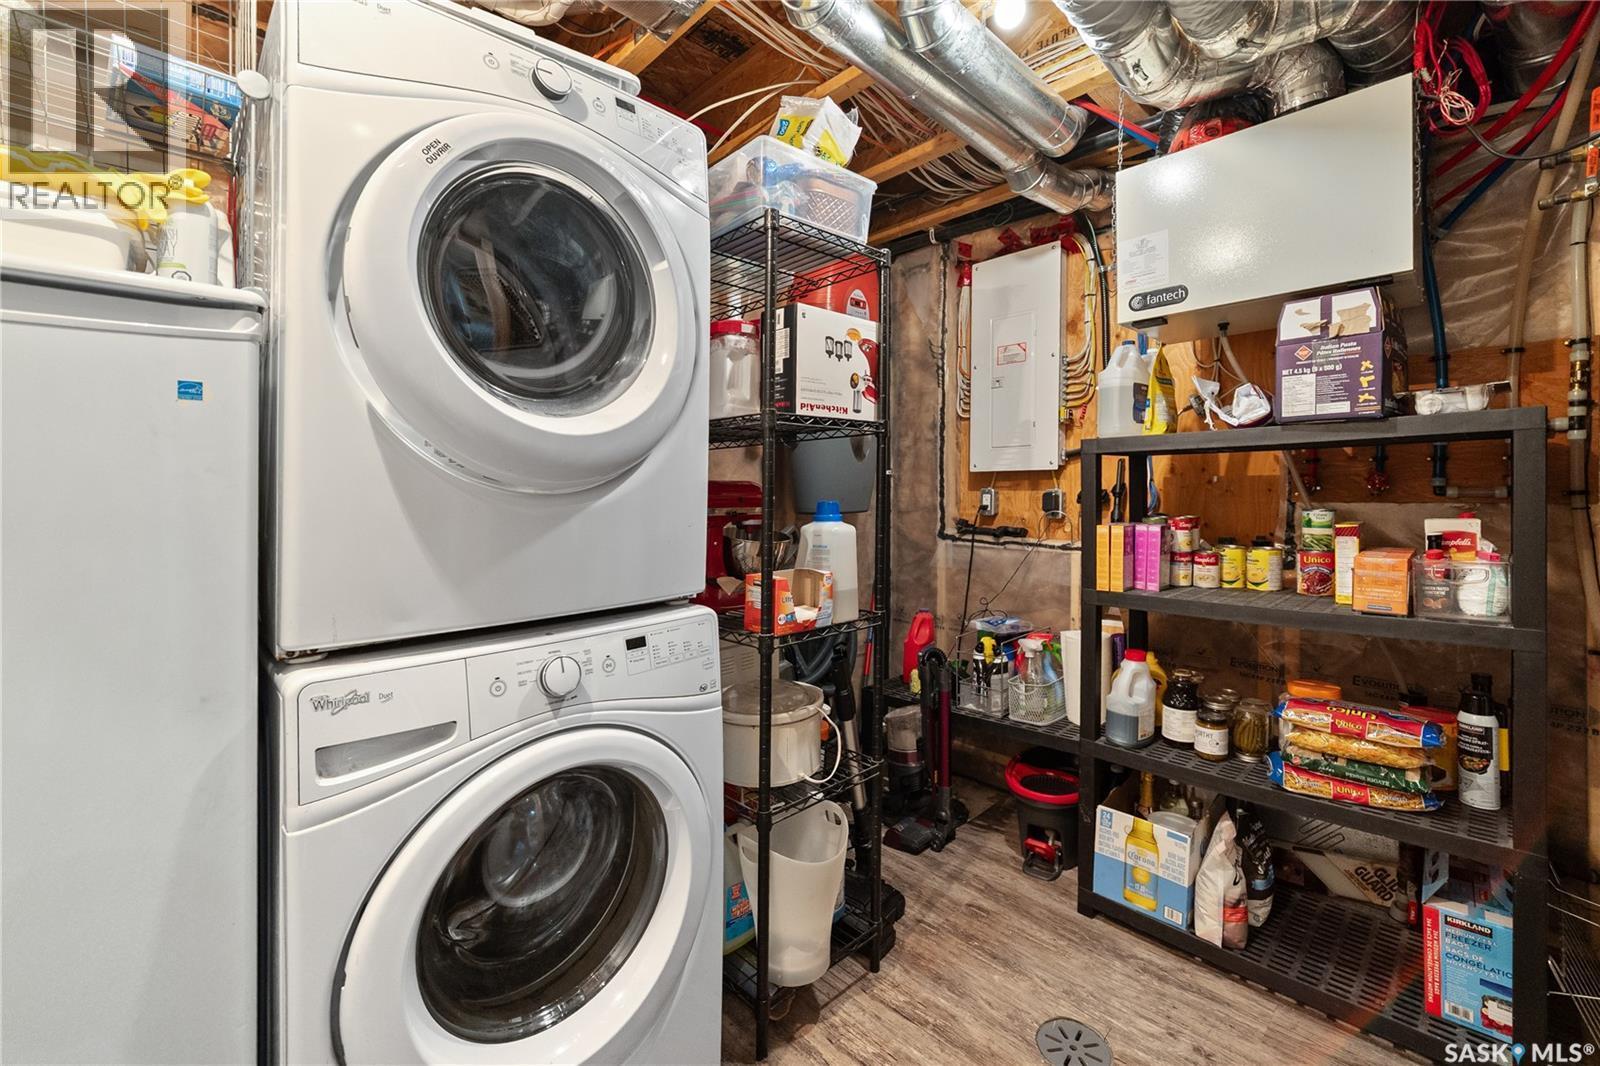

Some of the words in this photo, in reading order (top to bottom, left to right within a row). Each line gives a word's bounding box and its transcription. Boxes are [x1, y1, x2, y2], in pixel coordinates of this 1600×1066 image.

[421, 138, 442, 156] OPEN
[425, 142, 452, 165] OUVRIR
[1146, 288, 1186, 305] fantech
[799, 402, 848, 415] KitchenAid
[1303, 555, 1331, 564] Unico
[310, 690, 370, 715] Whirlpool
[378, 691, 394, 703] Duet
[1336, 785, 1365, 797] Unico
[1128, 850, 1156, 867] Corona
[1354, 865, 1394, 902] GUARD
[1446, 916, 1492, 935] KIRKLAND
[1445, 931, 1492, 952] FREEZER
[1445, 938, 1470, 951] BAGS
[1445, 952, 1513, 980] CONGÉLATIO
